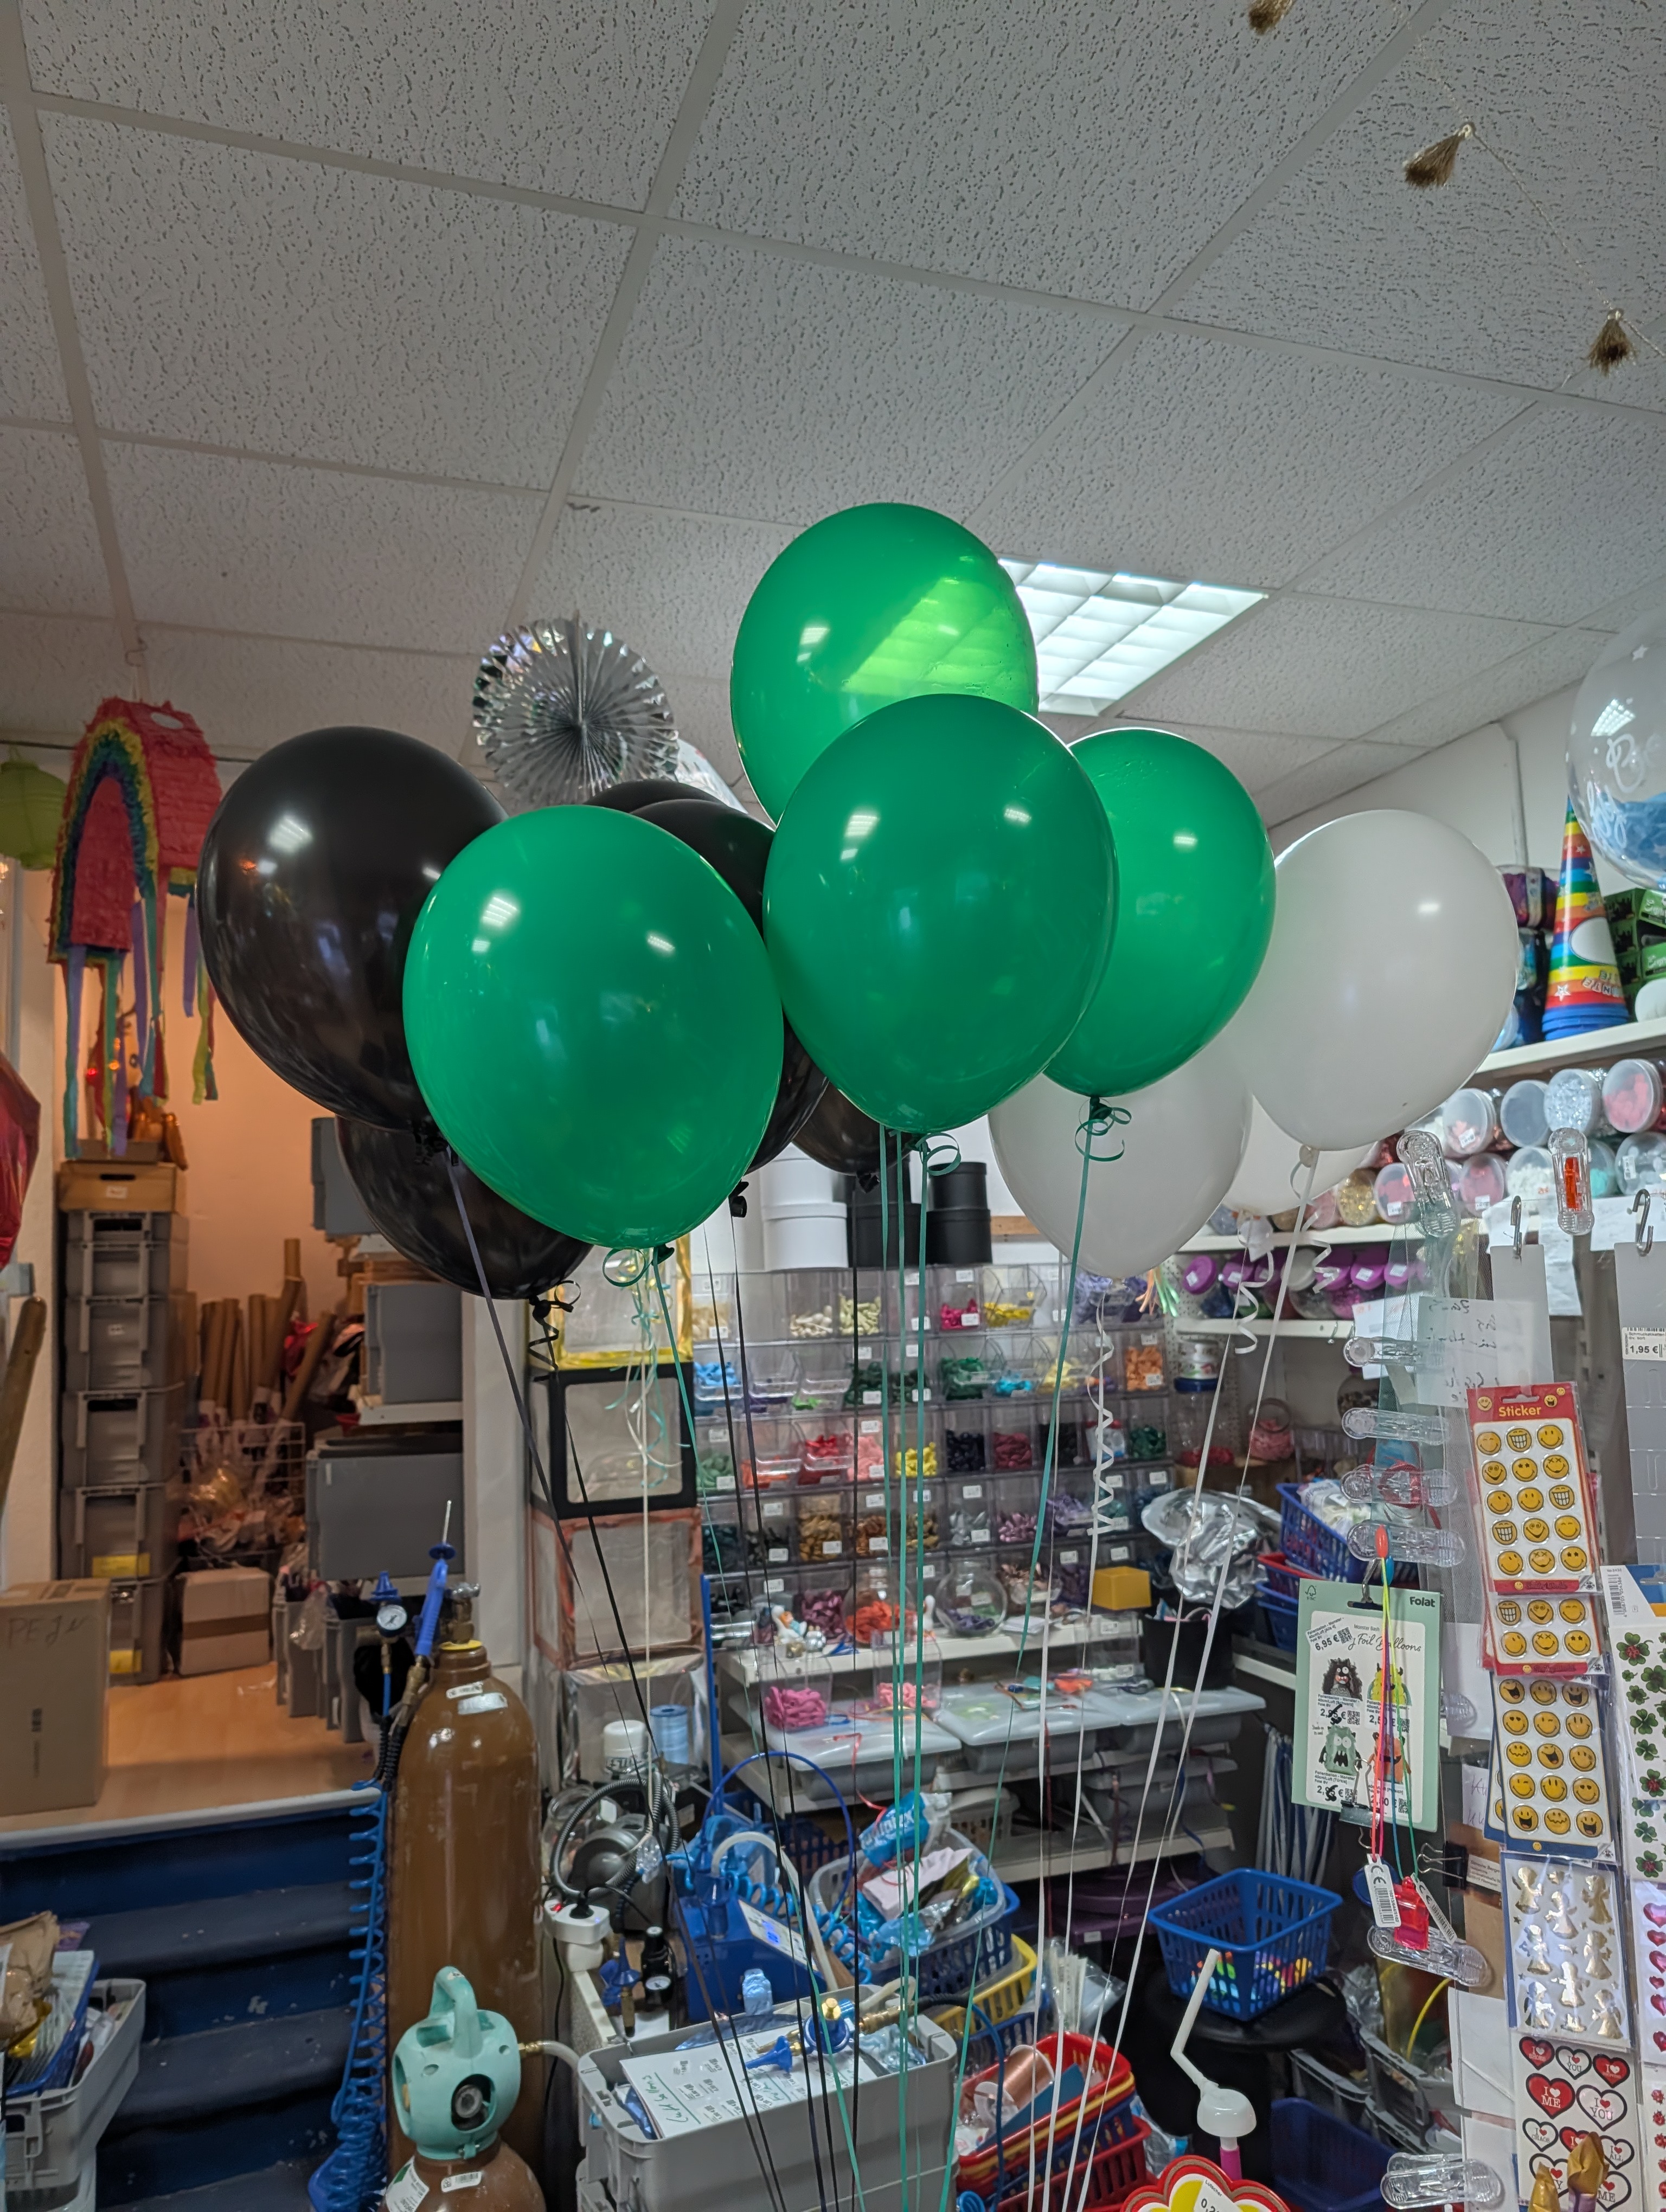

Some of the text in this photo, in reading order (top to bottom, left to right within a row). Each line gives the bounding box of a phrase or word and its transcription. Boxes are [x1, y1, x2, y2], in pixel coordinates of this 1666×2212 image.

[1630, 1345, 1659, 1354] 1,95 €
[1498, 1405, 1542, 1417] Sticker
[1409, 1596, 1436, 1607] Folat
[1315, 1634, 1340, 1651] 6,95 €
[1357, 1633, 1376, 1646] Foil
[1341, 1711, 1346, 1720] €
[1338, 1789, 1344, 1798] €
[1532, 2046, 1535, 2055] I
[1567, 2062, 1582, 2072] YOU
[1605, 2063, 1609, 2073] I
[1543, 2086, 1548, 2096] I
[1541, 2095, 1561, 2108] ME
[1594, 2097, 1599, 2107] I
[1590, 2107, 1614, 2121] YOU
[1570, 2136, 1574, 2146] I
[1610, 2145, 1613, 2153] I
[1598, 2190, 1616, 2203] ME
